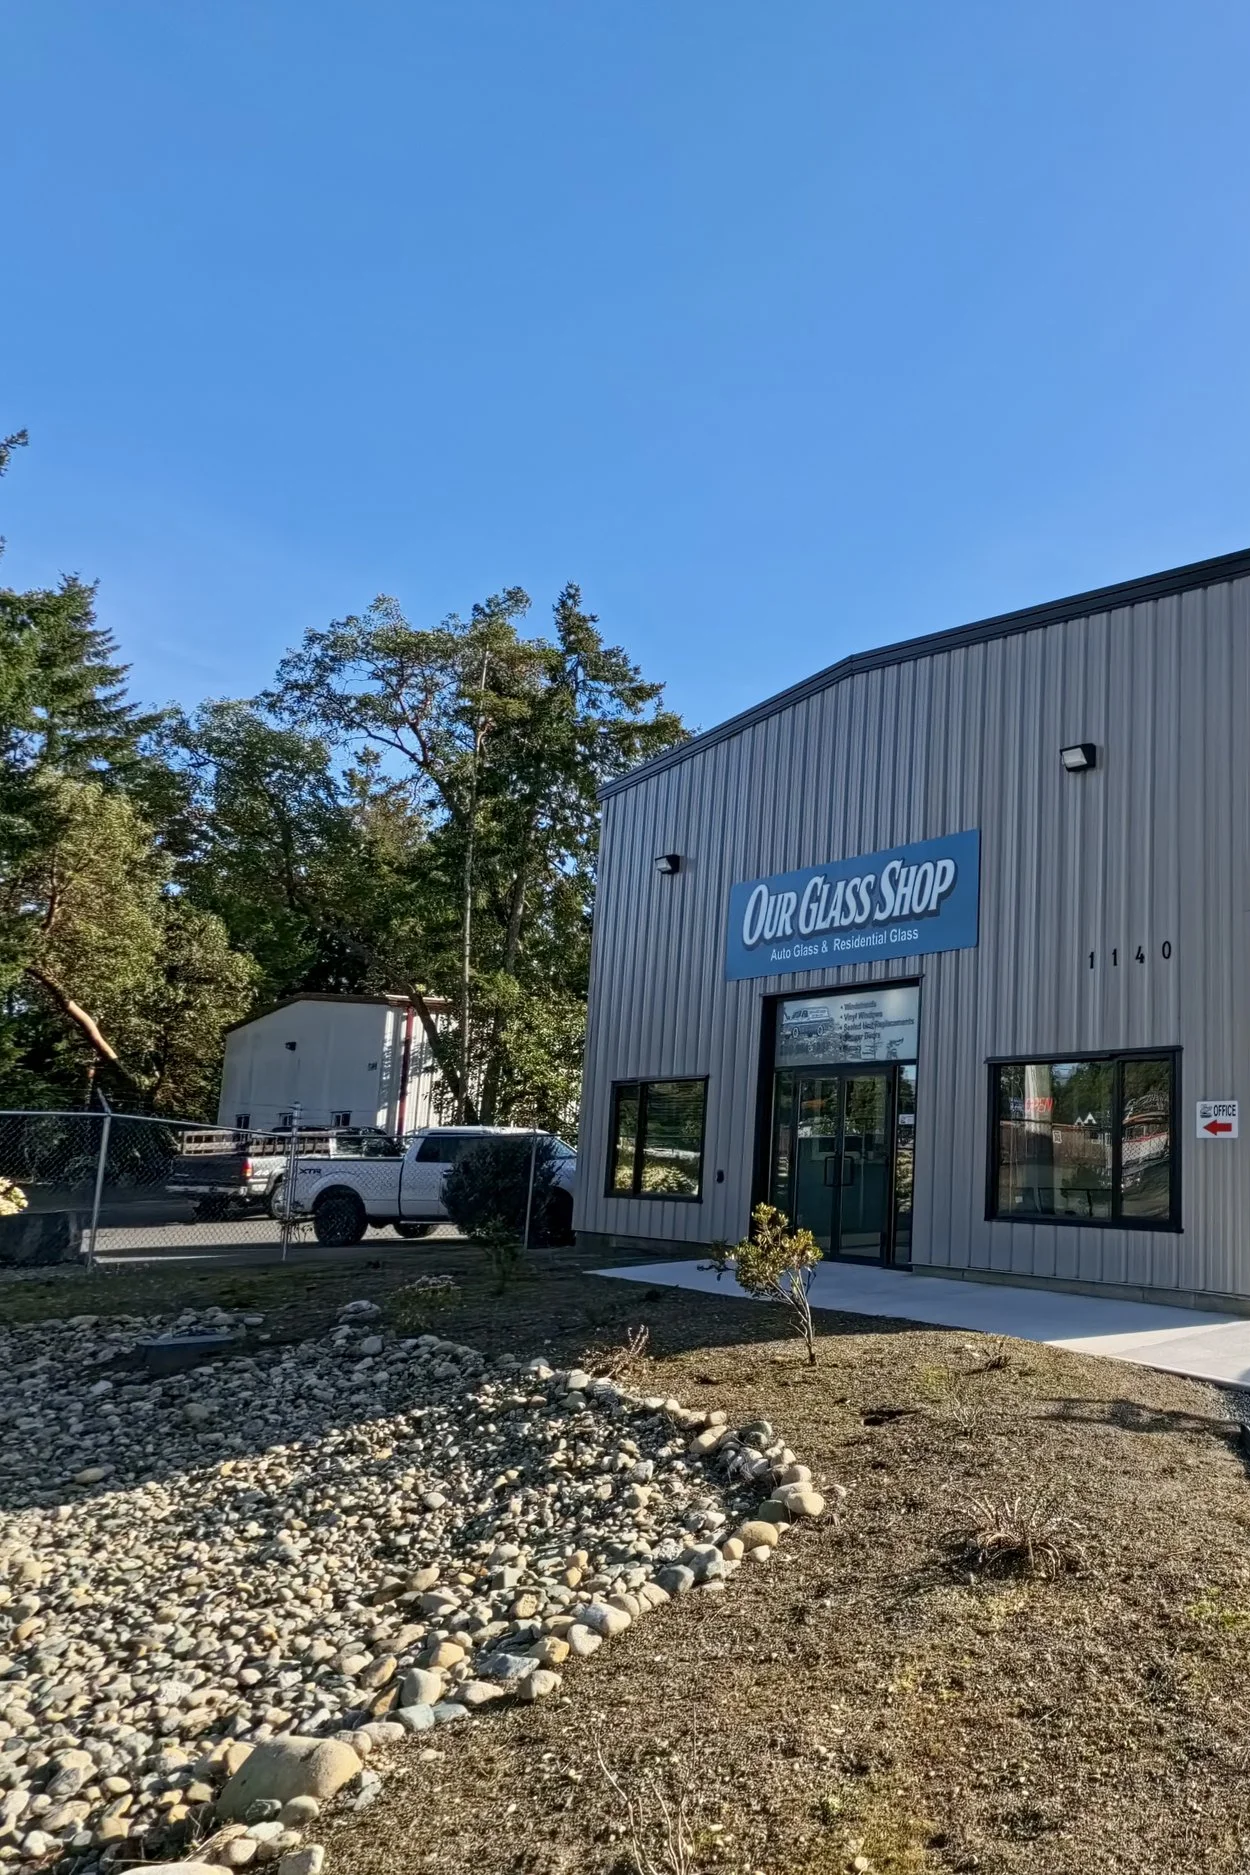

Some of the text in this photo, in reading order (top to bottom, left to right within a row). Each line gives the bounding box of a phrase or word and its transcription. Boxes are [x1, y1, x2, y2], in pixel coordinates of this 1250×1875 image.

[742, 859, 956, 946] OUR GLASS SHOP
[770, 928, 919, 961] Auto Glass & Residential Glass
[1088, 940, 1172, 969] 1140
[1213, 1104, 1237, 1117] OFFICE
